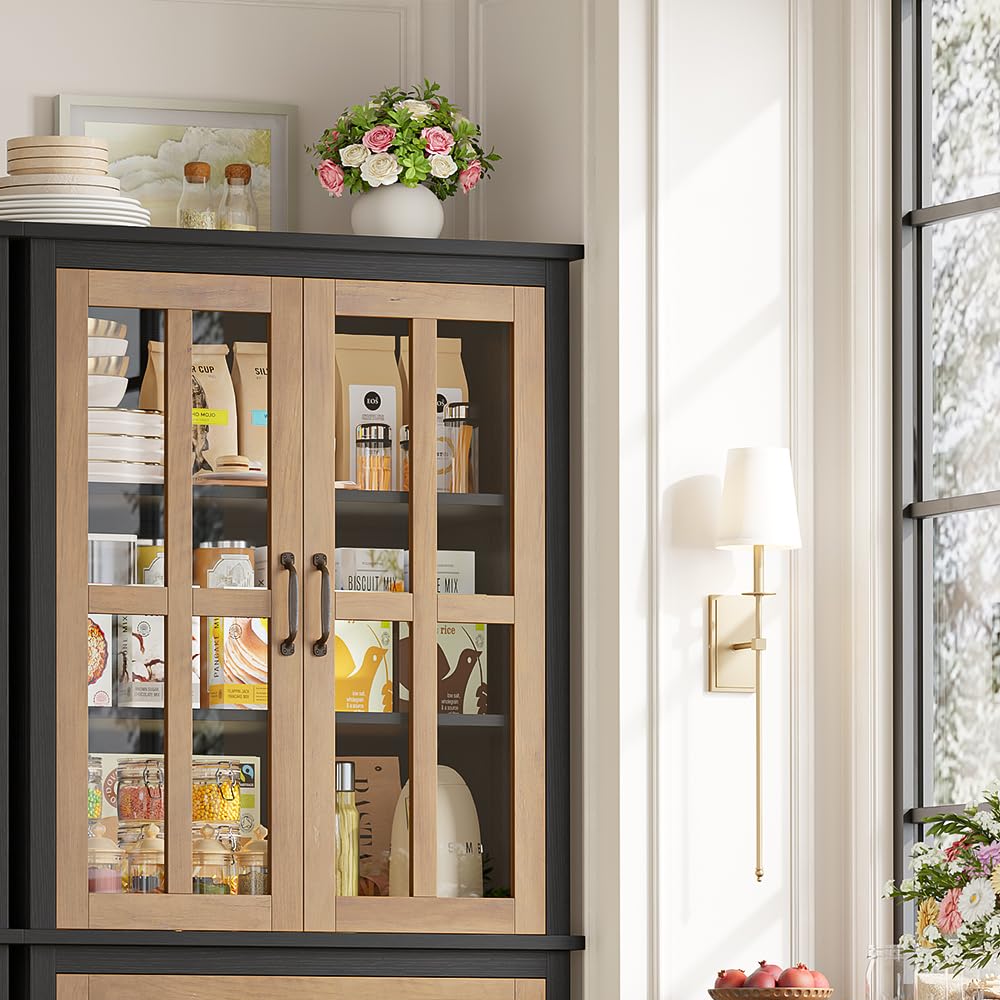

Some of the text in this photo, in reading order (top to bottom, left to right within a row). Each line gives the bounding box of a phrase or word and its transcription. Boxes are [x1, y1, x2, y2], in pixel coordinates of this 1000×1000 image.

[254, 368, 268, 376] SIL
[348, 576, 397, 592] BISCUIT MIX
[444, 578, 458, 593] MIX
[440, 625, 456, 634] rice
